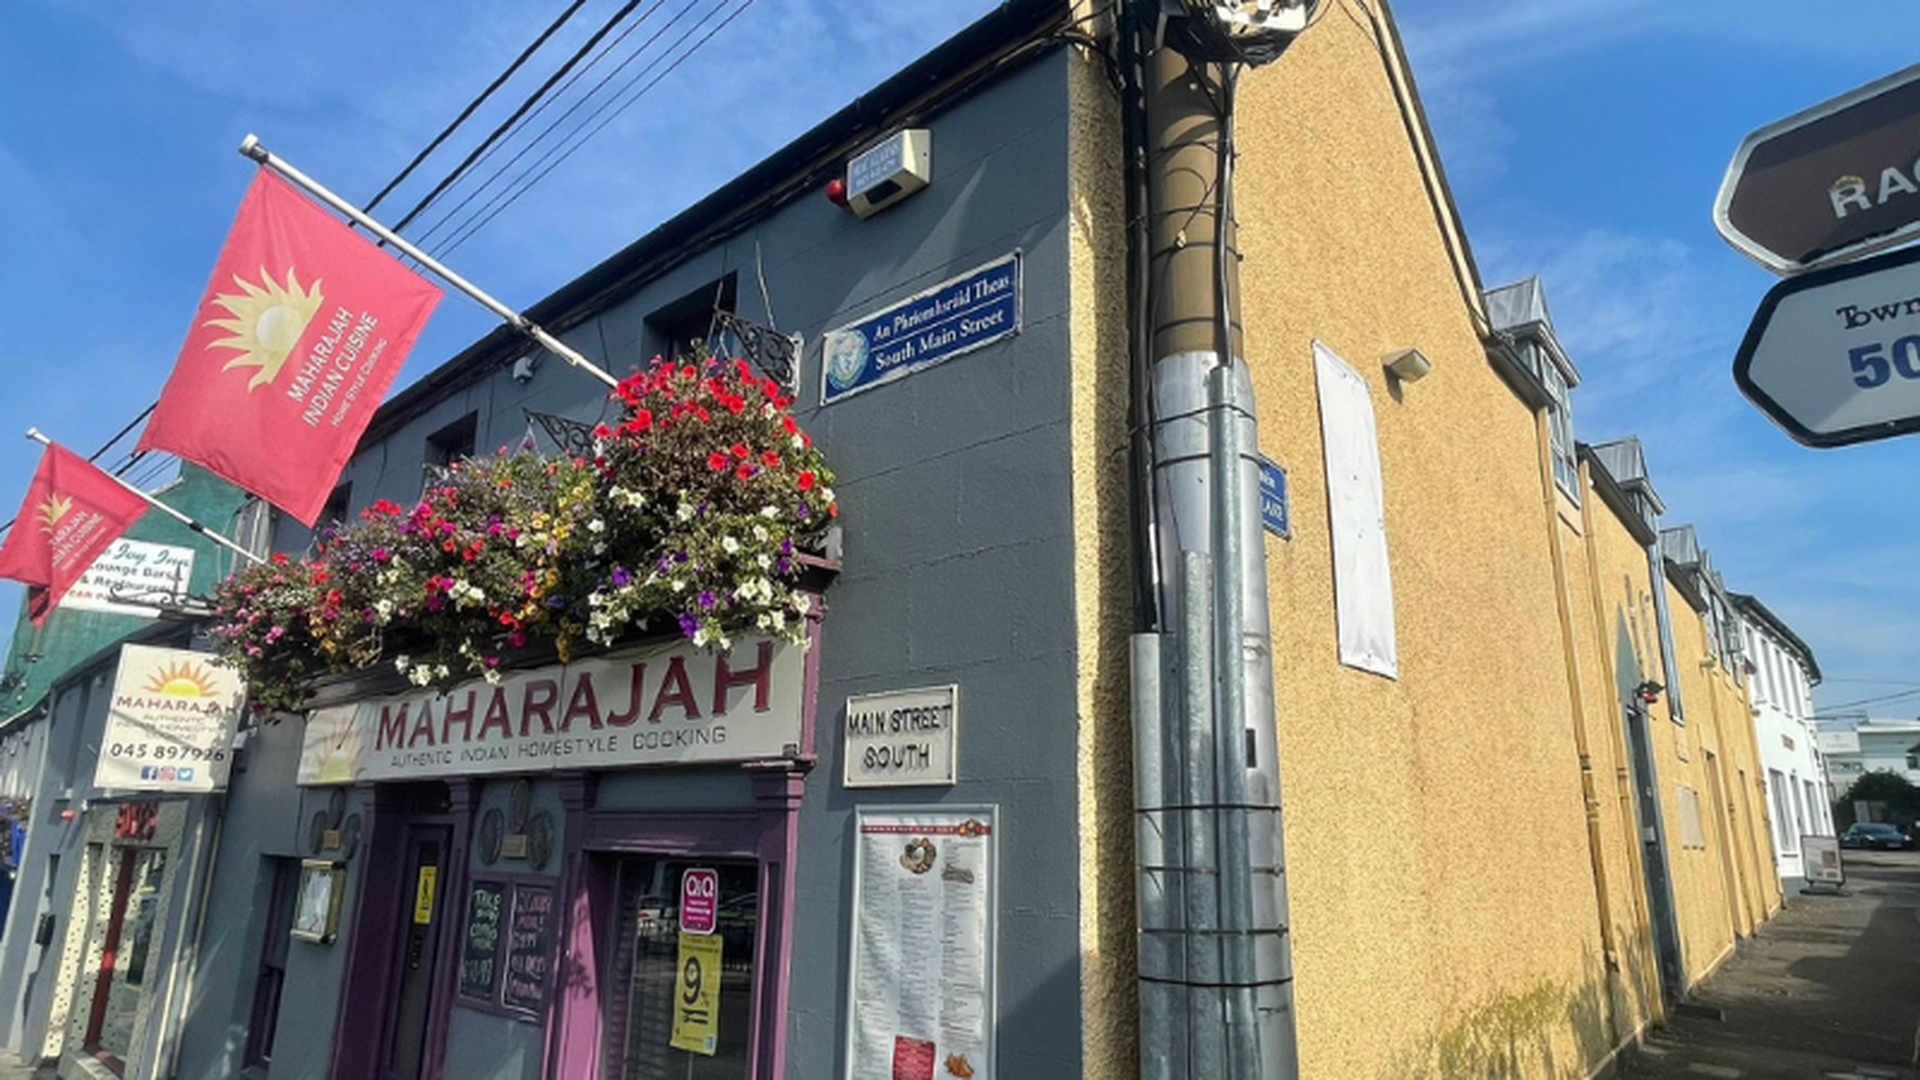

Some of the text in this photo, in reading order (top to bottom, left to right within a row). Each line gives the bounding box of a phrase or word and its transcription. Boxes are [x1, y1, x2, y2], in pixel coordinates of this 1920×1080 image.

[1829, 158, 1920, 219] RA
[874, 325, 891, 341] An
[973, 274, 1010, 299] Theas
[286, 306, 354, 403] MAHARAJAH
[875, 309, 1004, 371] South Main Street
[302, 310, 378, 428] INDIAN CUISINE
[90, 563, 138, 577] ounge
[116, 696, 237, 716] MAHARAJAH
[375, 641, 774, 751] MAHARAJAH
[849, 703, 953, 735] MAIN STREET
[110, 742, 224, 762] 045 897926
[460, 746, 510, 762] INDIAN
[518, 735, 618, 759] HOMESTYLE
[633, 725, 726, 750] COOKING
[863, 743, 930, 769] SOUTH
[683, 956, 702, 1006] 9
